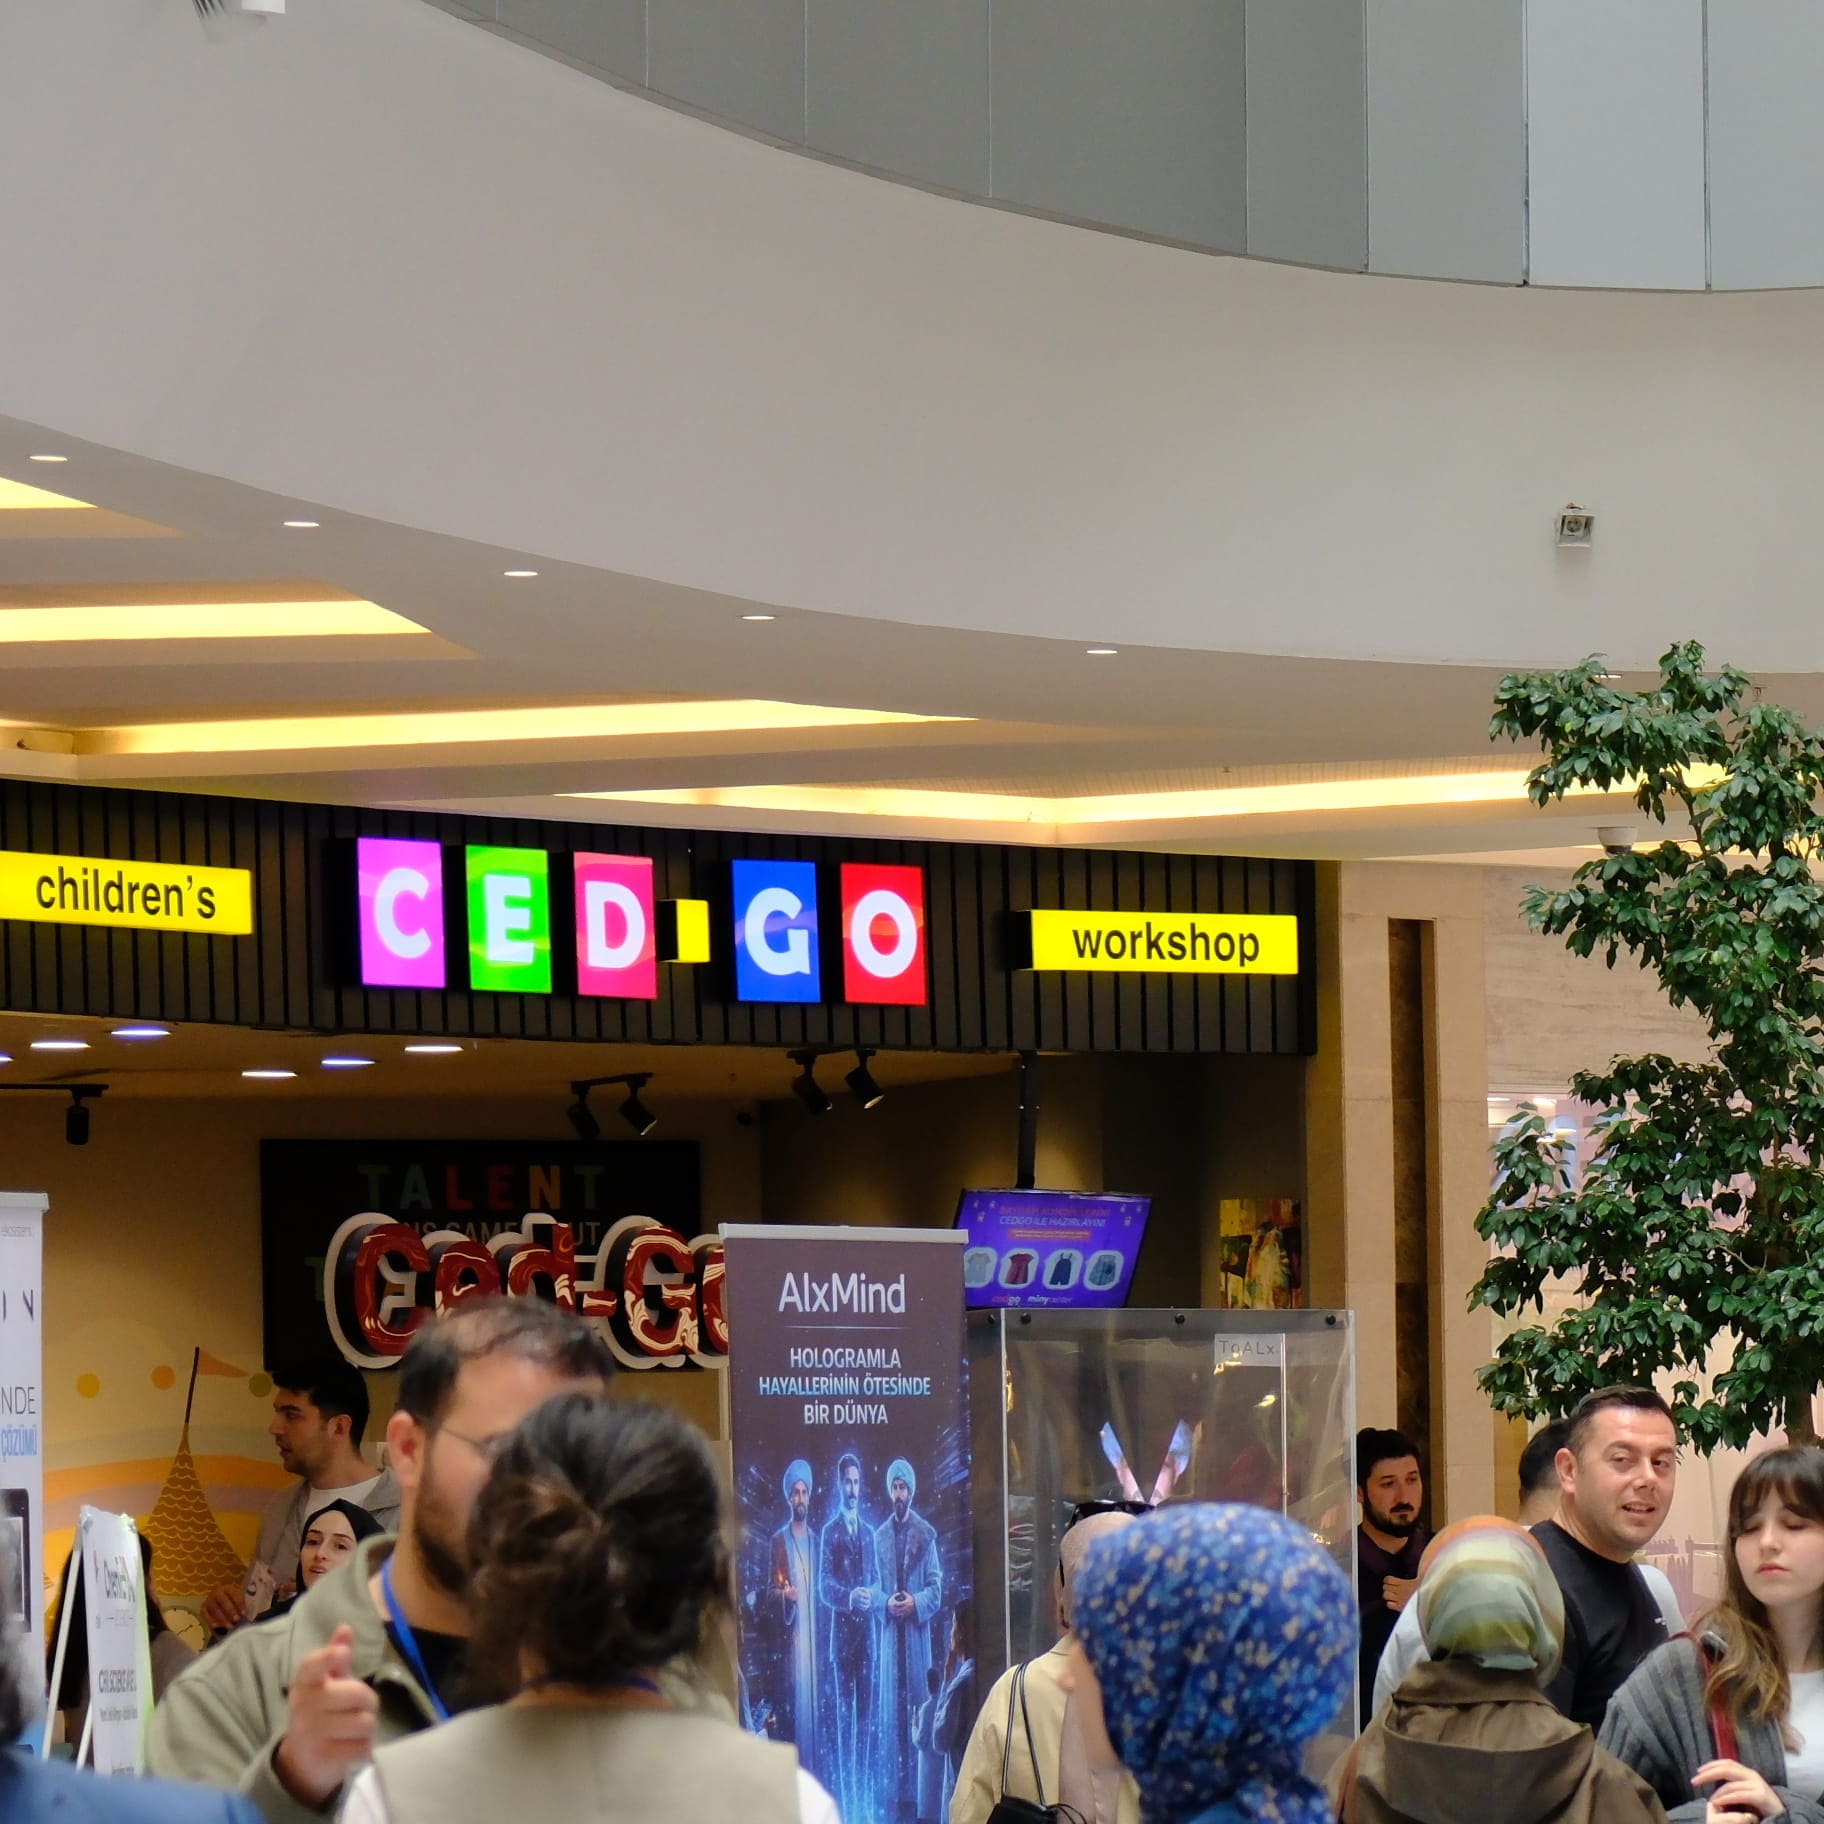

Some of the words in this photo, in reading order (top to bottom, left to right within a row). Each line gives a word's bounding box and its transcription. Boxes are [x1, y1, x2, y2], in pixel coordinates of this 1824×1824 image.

[35, 866, 217, 918] children's
[1072, 922, 1262, 966] workshop
[358, 1164, 606, 1210] TALENT
[790, 1347, 901, 1369] HOLOGRAMLA
[758, 1373, 860, 1395] HAYALLERİNİN
[863, 1372, 932, 1395] ÖTESİNDE
[804, 1399, 830, 1425] BİR
[834, 1399, 889, 1425] DÜNYA
